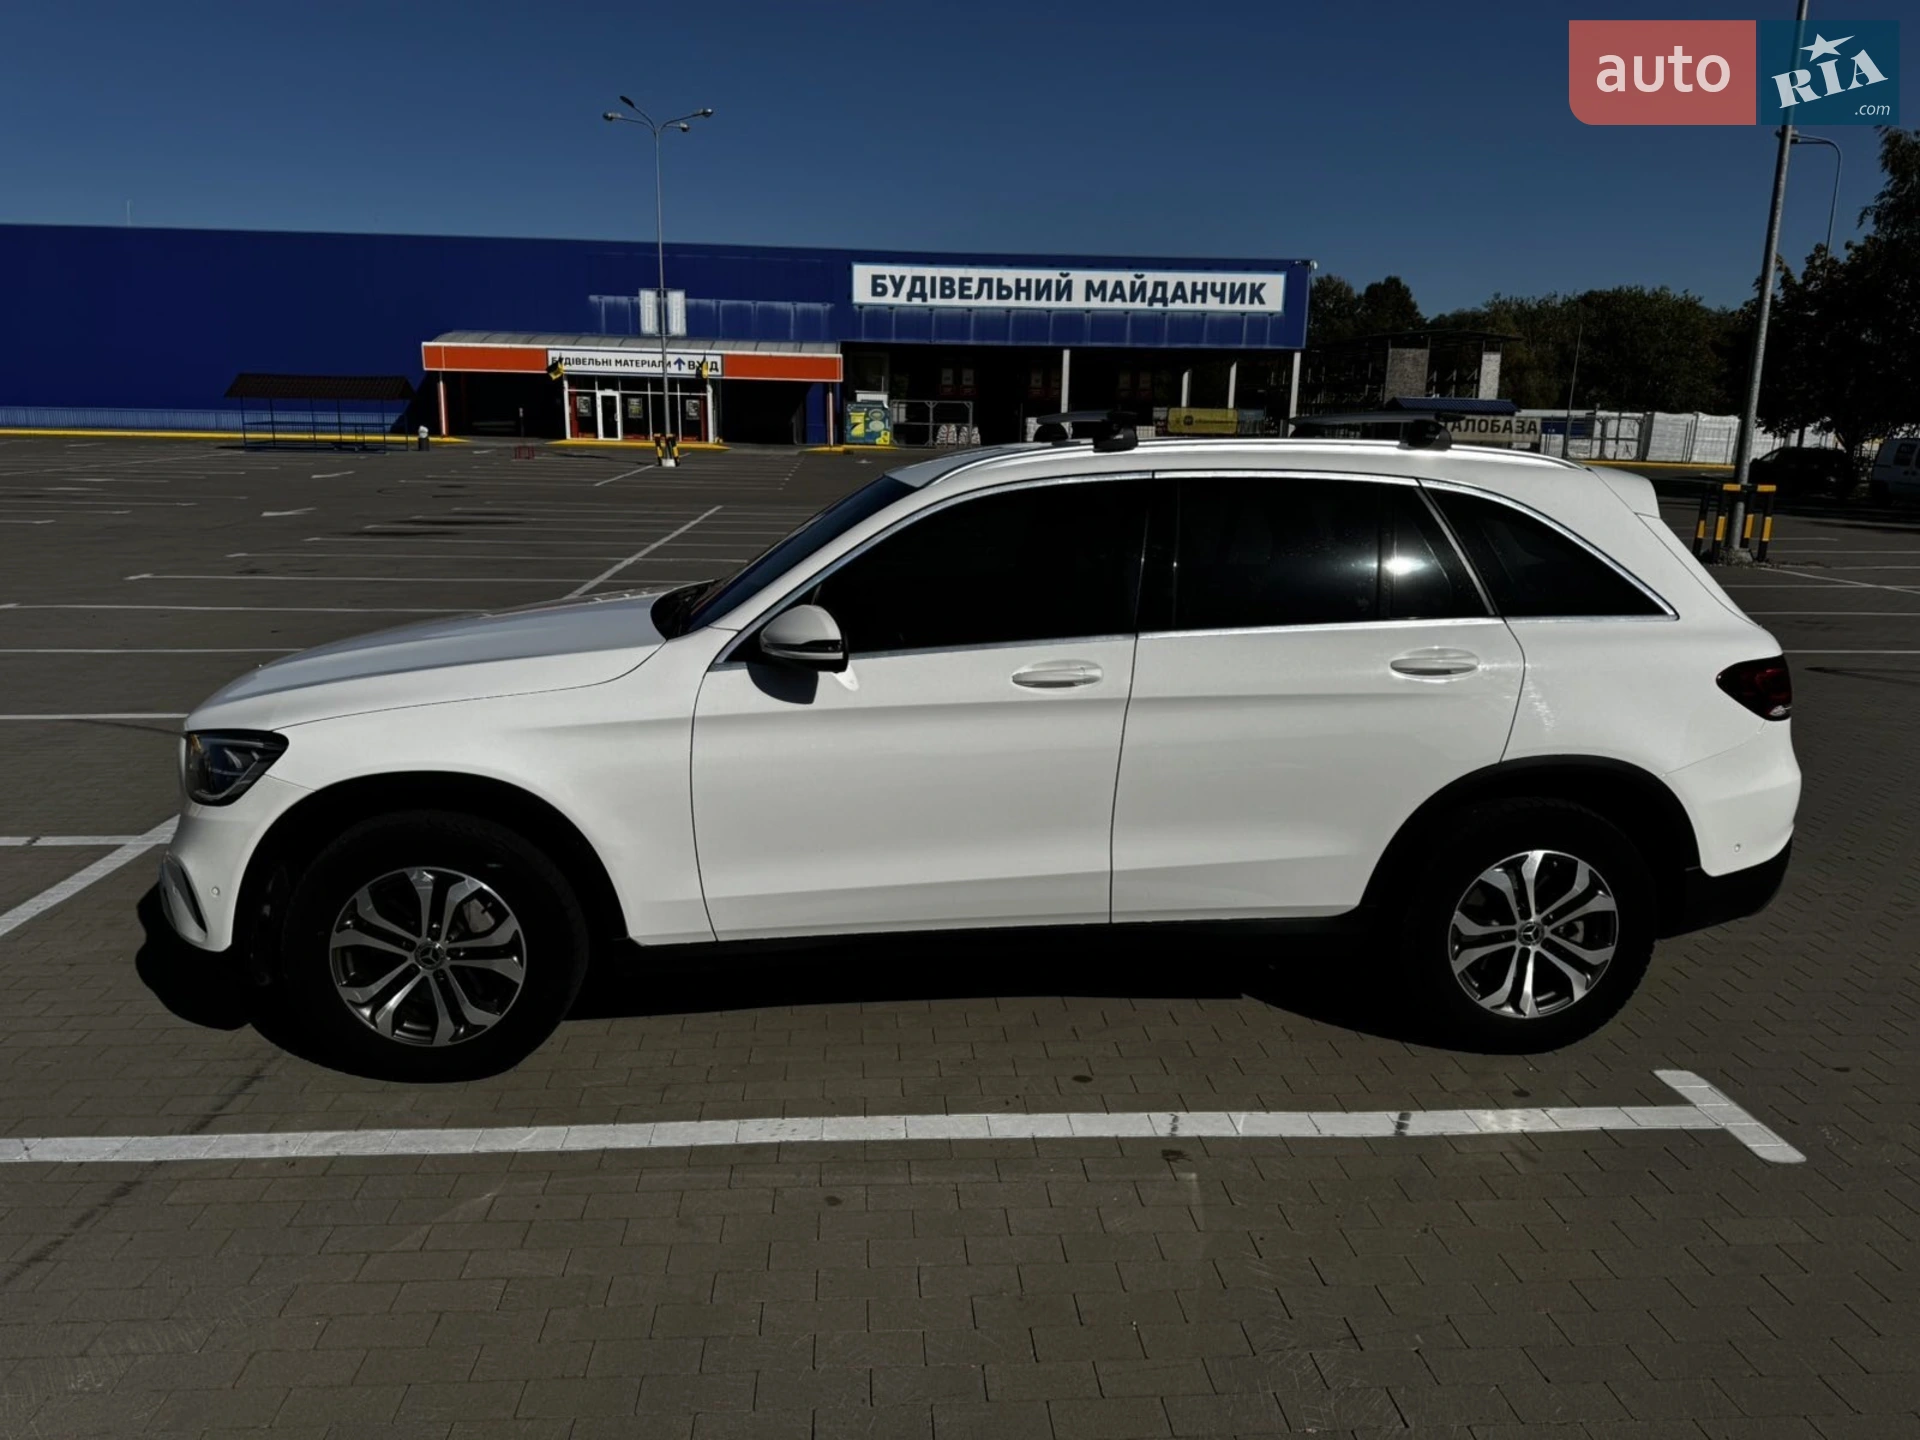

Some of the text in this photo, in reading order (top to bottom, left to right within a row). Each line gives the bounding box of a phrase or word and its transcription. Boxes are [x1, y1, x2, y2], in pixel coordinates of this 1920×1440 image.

[871, 272, 1267, 307] БУДІВЕЛЬНИЙ МАЙДАНЧИК
[551, 356, 612, 367] БДІВЕЛЬНІ
[688, 360, 719, 373] ВХД
